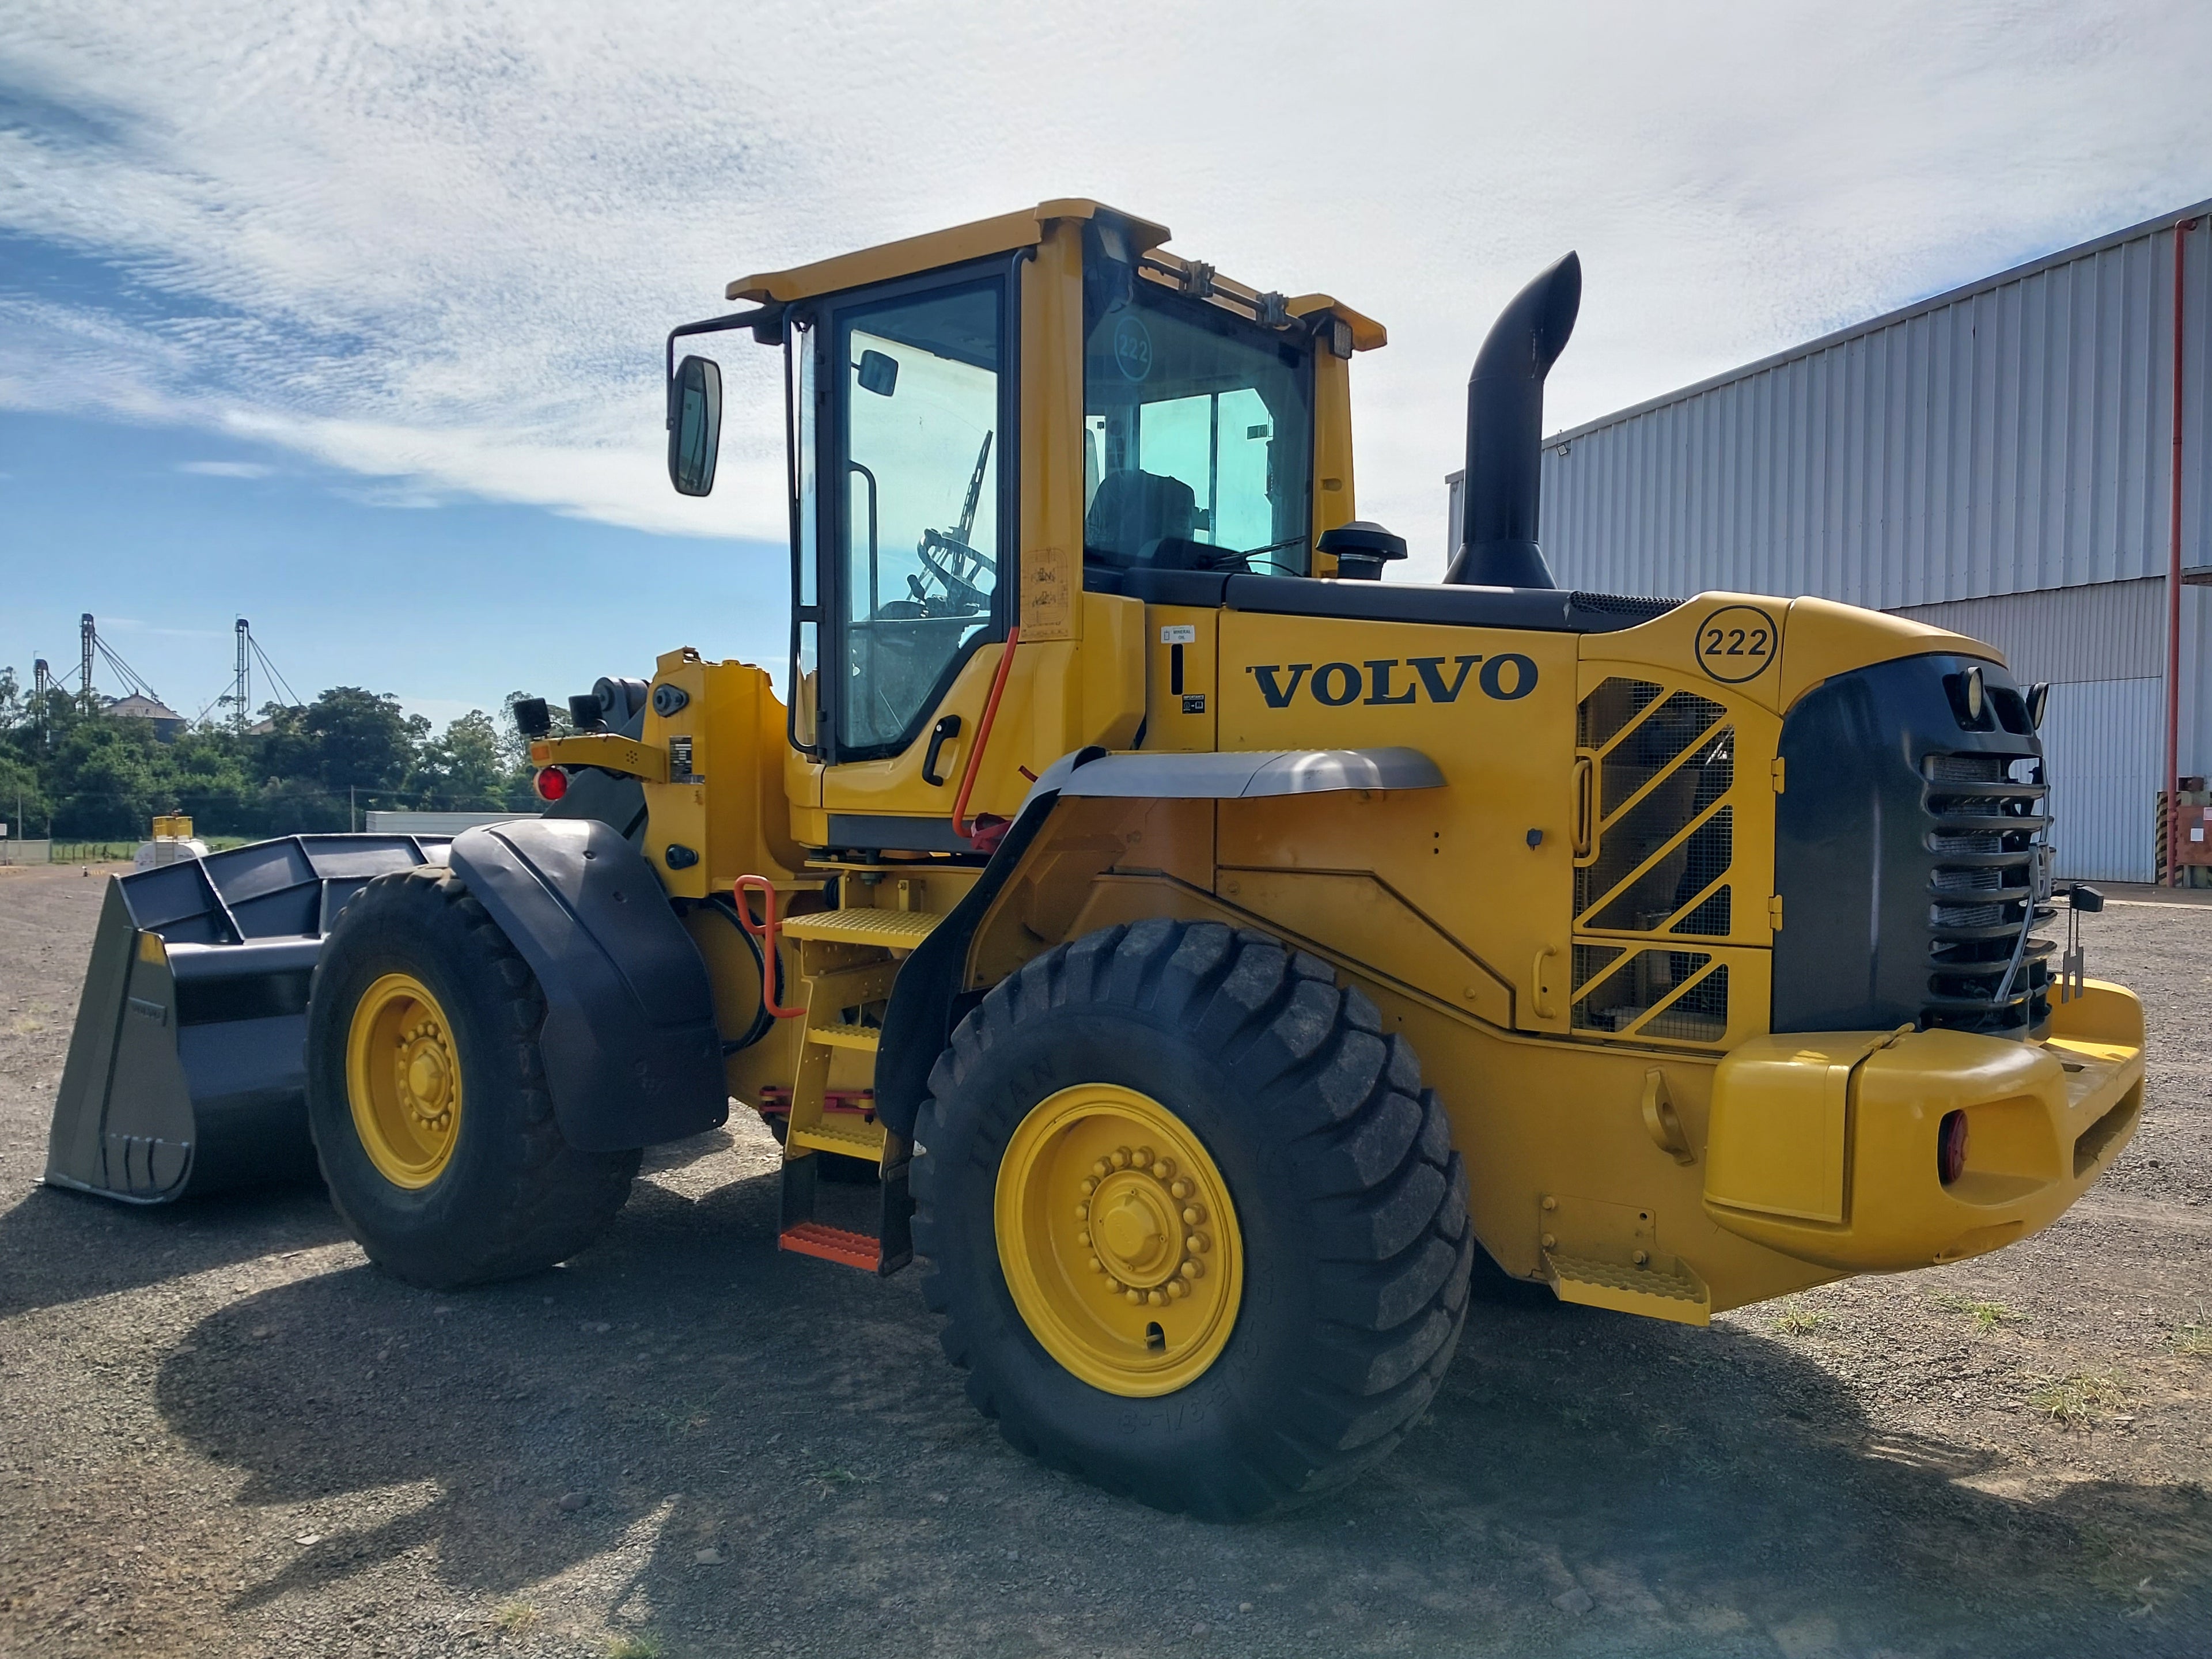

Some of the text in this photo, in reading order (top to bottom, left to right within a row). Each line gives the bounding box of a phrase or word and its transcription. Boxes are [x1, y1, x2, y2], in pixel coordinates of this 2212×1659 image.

[1119, 334, 1148, 362] 222
[1705, 628, 1768, 655] 222
[1245, 653, 1539, 708] VOLVO
